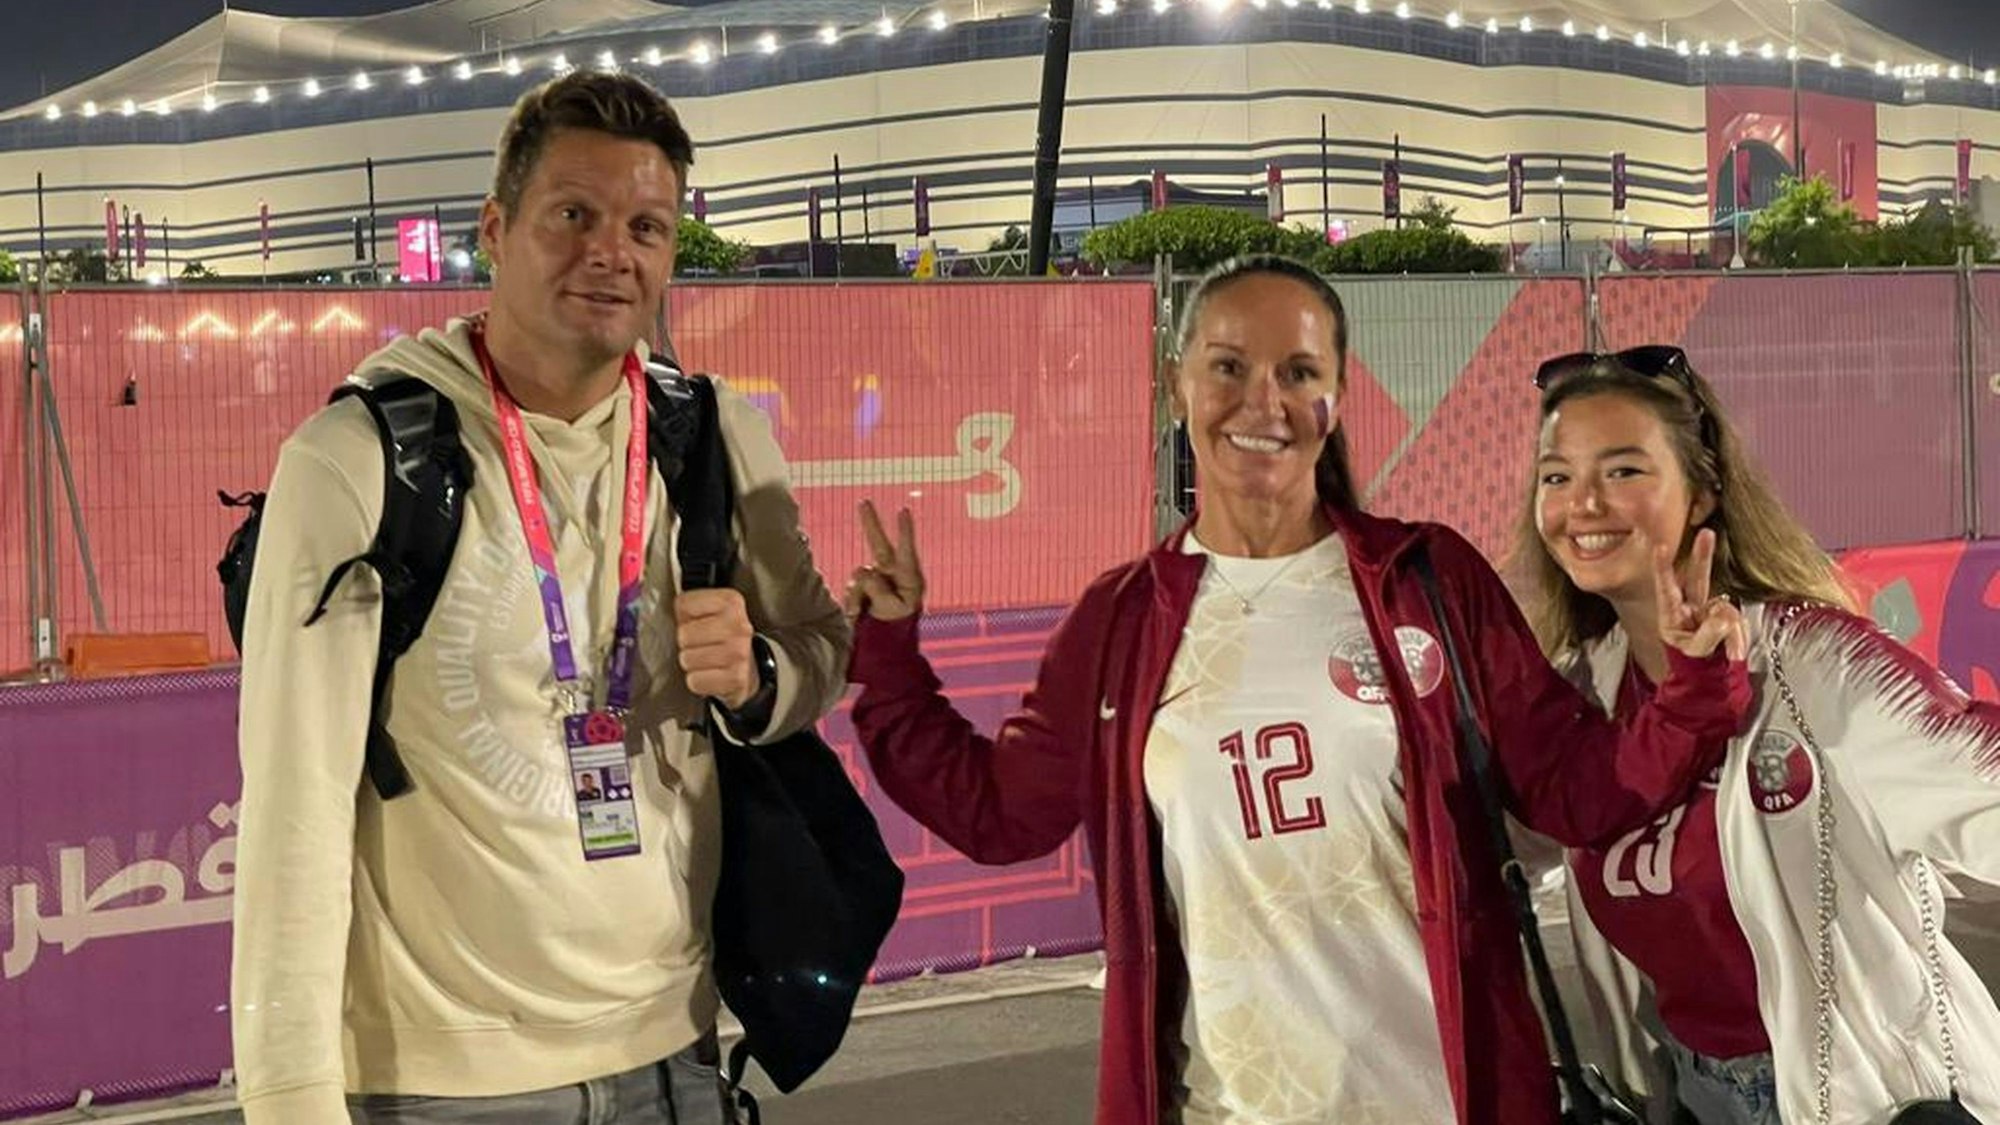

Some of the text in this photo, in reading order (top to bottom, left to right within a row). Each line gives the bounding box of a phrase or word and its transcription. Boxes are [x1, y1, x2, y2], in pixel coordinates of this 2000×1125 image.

[437, 565, 491, 711] QUALITY
[1218, 721, 1327, 840] 12
[1764, 791, 1796, 811] QFA
[3, 800, 240, 979] قطر
